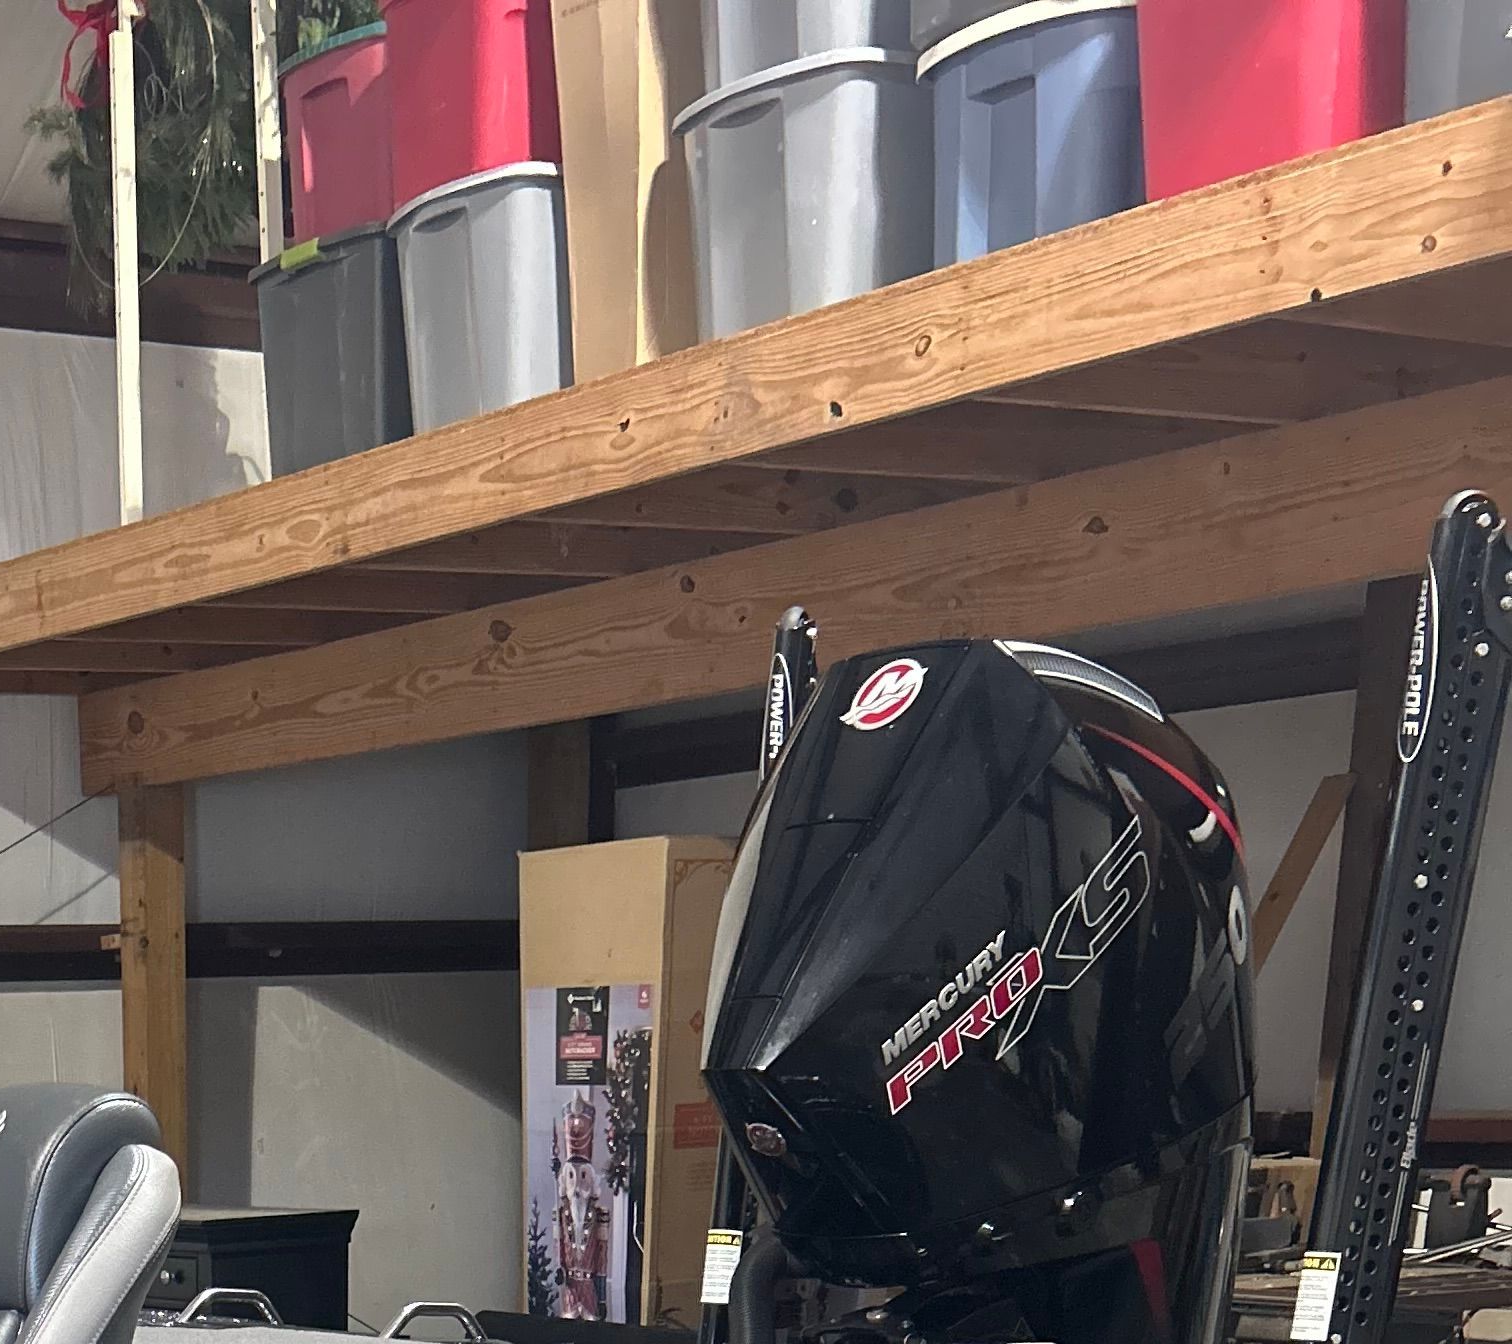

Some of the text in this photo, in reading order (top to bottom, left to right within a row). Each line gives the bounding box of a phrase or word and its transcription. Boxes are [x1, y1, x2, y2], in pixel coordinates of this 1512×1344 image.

[768, 673, 785, 759] POWER-
[1401, 579, 1430, 738] POWER-POLE
[881, 930, 1006, 1066] MERCURY
[886, 946, 1043, 1115] PRO
